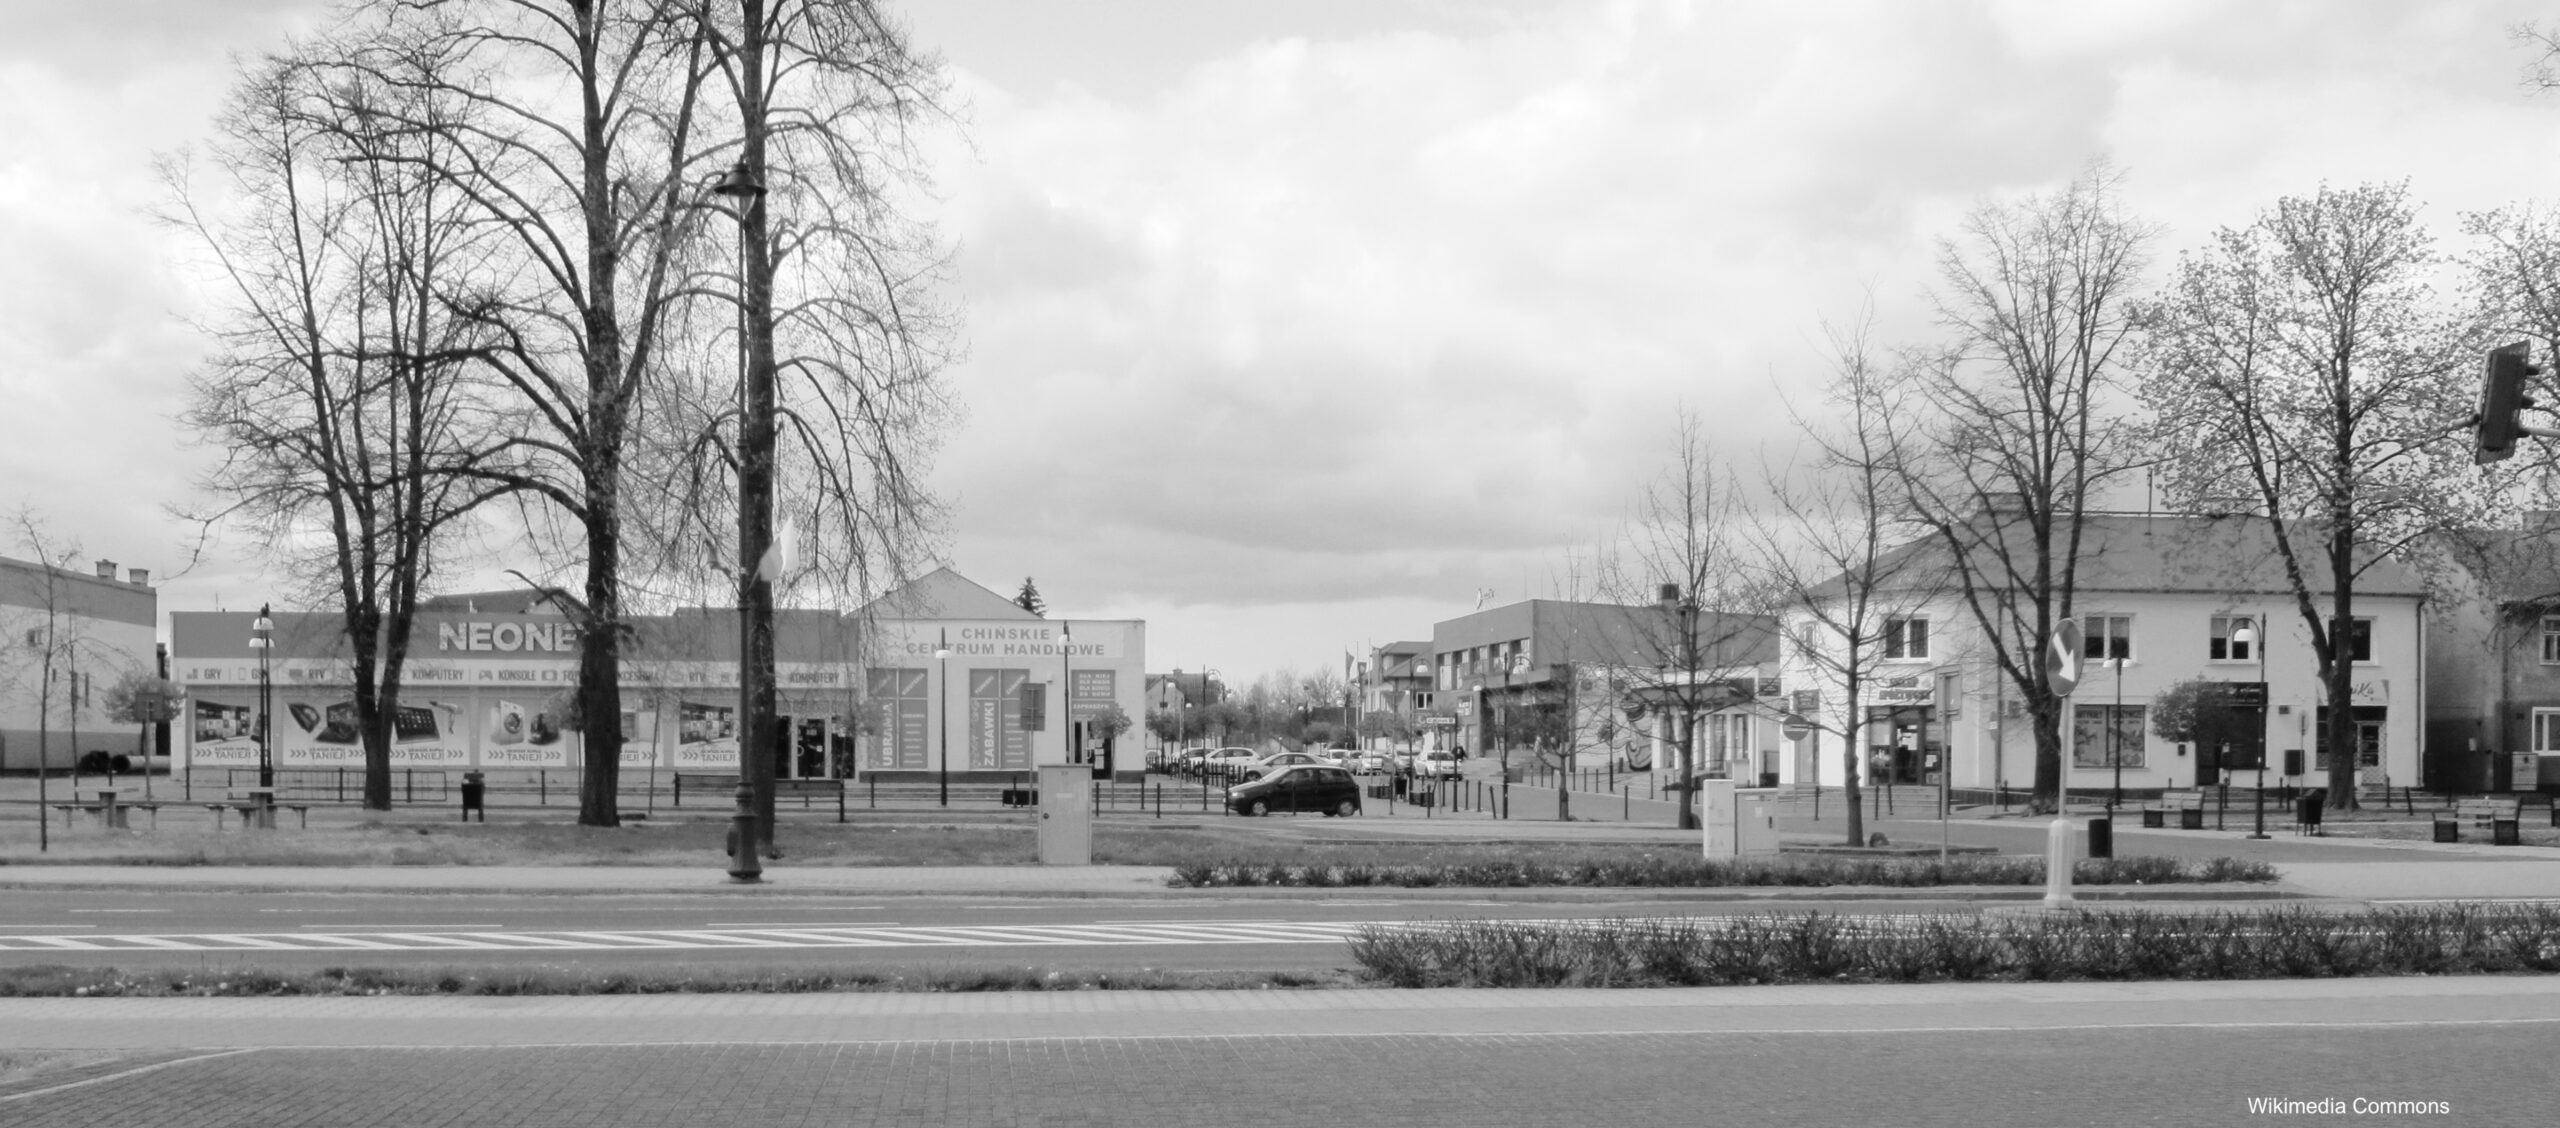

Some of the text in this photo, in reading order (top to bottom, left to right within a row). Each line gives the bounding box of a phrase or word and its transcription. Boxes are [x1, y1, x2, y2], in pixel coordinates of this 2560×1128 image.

[439, 622, 585, 651] NEONE
[962, 625, 1050, 640] CHIŃSKIE
[906, 643, 1104, 655] CENTRUM HANDLOWE
[204, 668, 222, 680] GRY
[412, 669, 464, 680] KOMPUTERY
[499, 669, 536, 681] KONSOLE
[882, 703, 893, 766] UBRANIA
[984, 702, 995, 766] ZABAWKI
